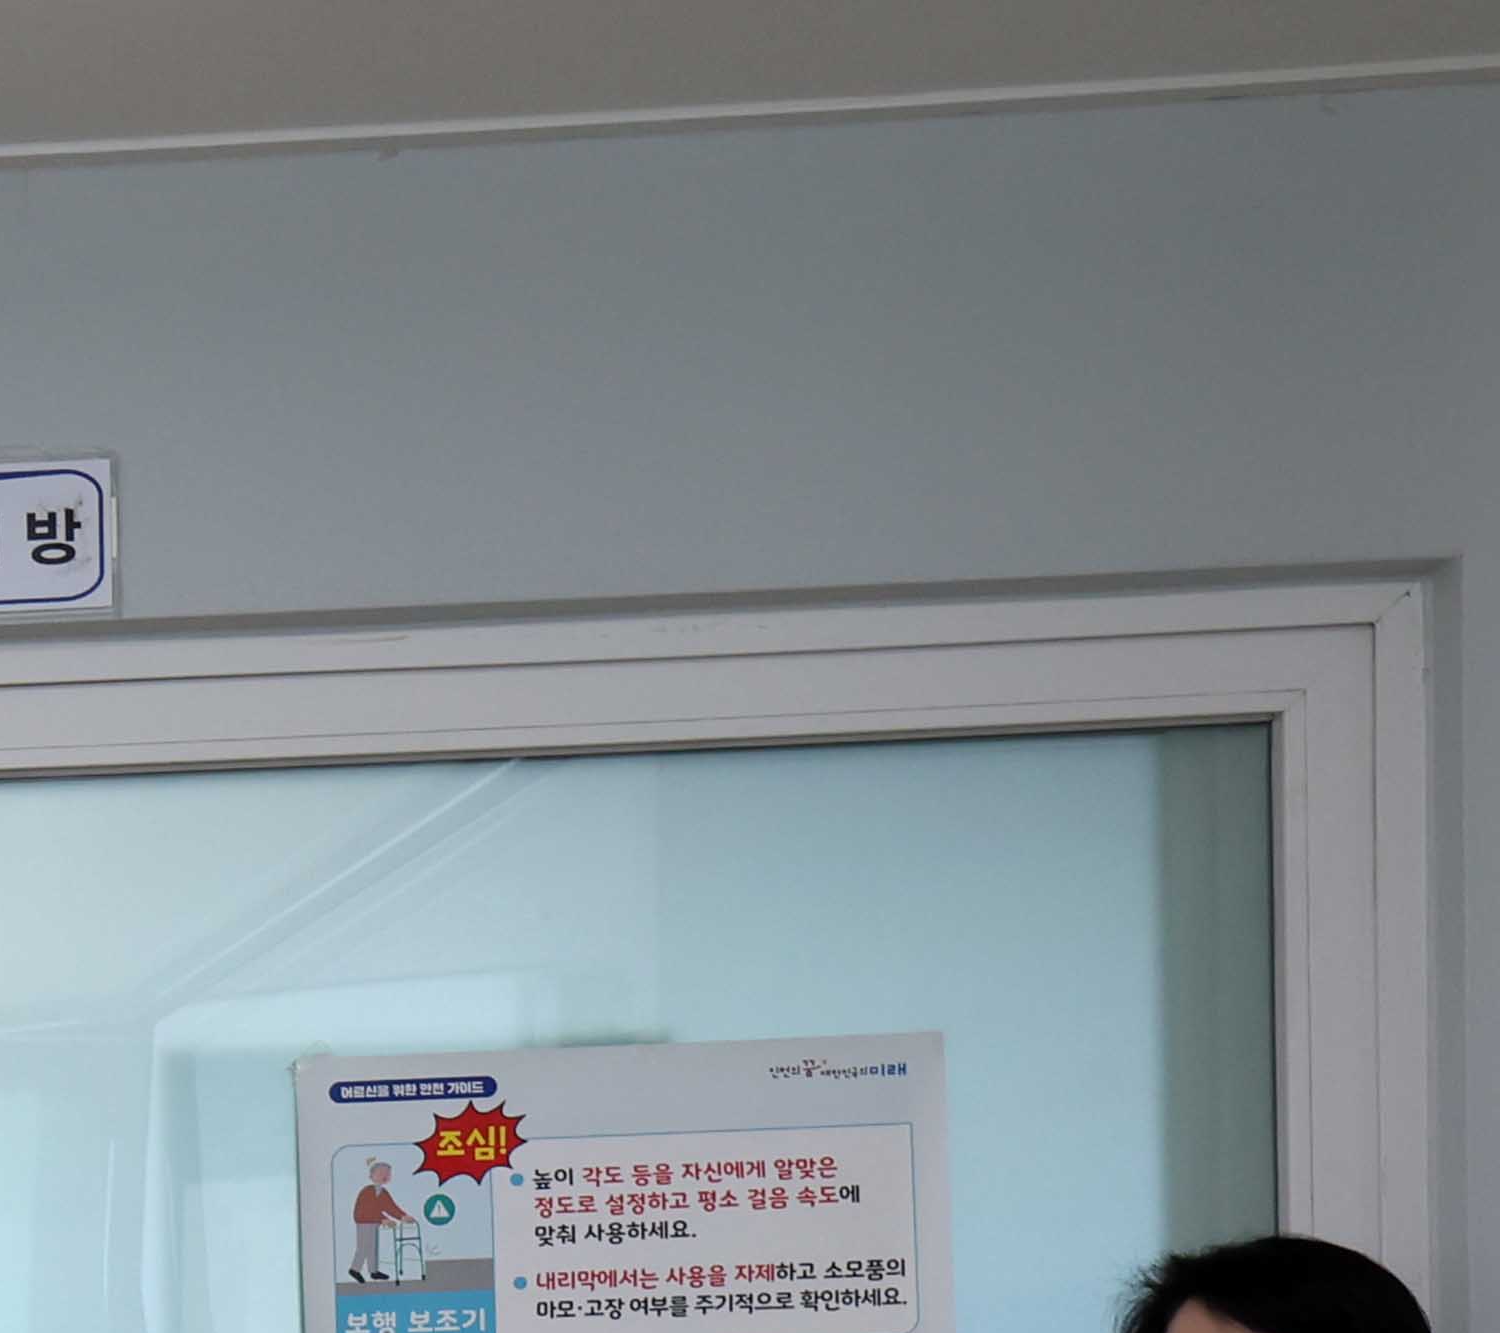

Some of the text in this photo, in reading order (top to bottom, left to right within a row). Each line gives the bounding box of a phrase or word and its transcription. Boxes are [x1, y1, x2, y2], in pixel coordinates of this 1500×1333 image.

[26, 507, 82, 566] 방
[869, 1061, 907, 1076] 미래
[340, 1080, 485, 1099] 어르신을 위한 안전 가이드
[436, 1125, 507, 1161] 조심!
[532, 1156, 838, 1190] 높이 각도 등을 자신에게 알맞은
[533, 1184, 861, 1219] 정도로 설정하고 평소 걸음 속도에
[534, 1220, 697, 1247] 맞춰 사용하세요.
[535, 1258, 906, 1292] 내리막에서는 사용을 자제하고 소모품의
[407, 1307, 487, 1333] 보조기
[536, 1287, 908, 1321] 마모·고장 여부를 주기적으로 확인하세요.
